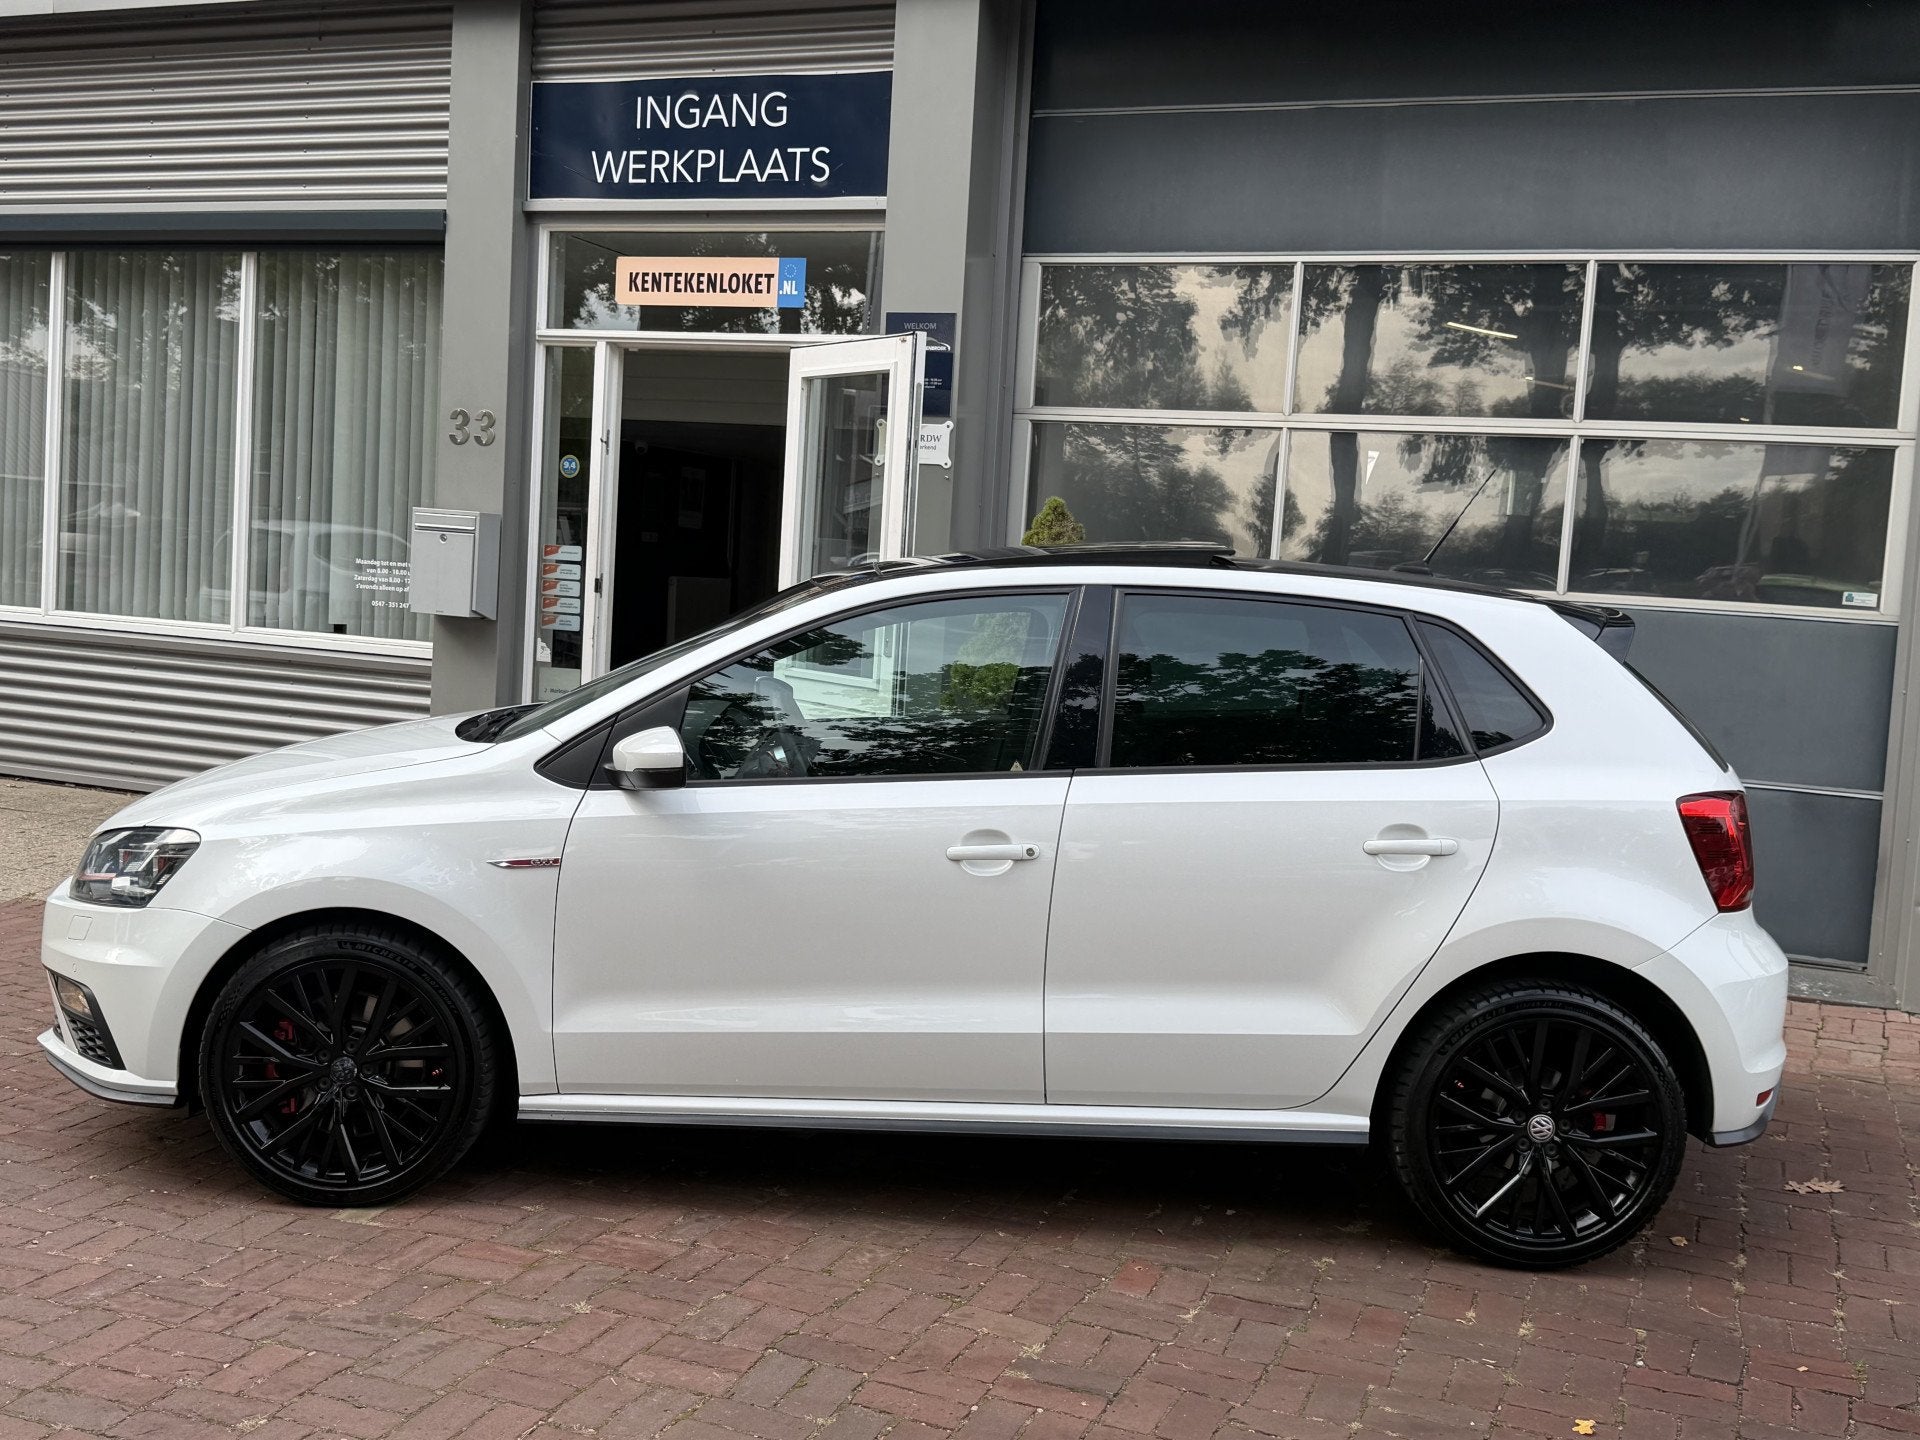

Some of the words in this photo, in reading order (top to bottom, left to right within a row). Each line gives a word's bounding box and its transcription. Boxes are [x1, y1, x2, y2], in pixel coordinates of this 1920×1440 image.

[636, 91, 788, 129] INGANG
[591, 146, 830, 183] WERKPLAATS
[628, 271, 775, 295] KENTEKENLOKET
[903, 322, 937, 330] WELKOM
[448, 407, 496, 447] 33
[920, 434, 943, 443] RDW
[355, 558, 380, 566] Maandag
[354, 574, 378, 583] Zaterdag
[355, 942, 417, 969] MICHELIN
